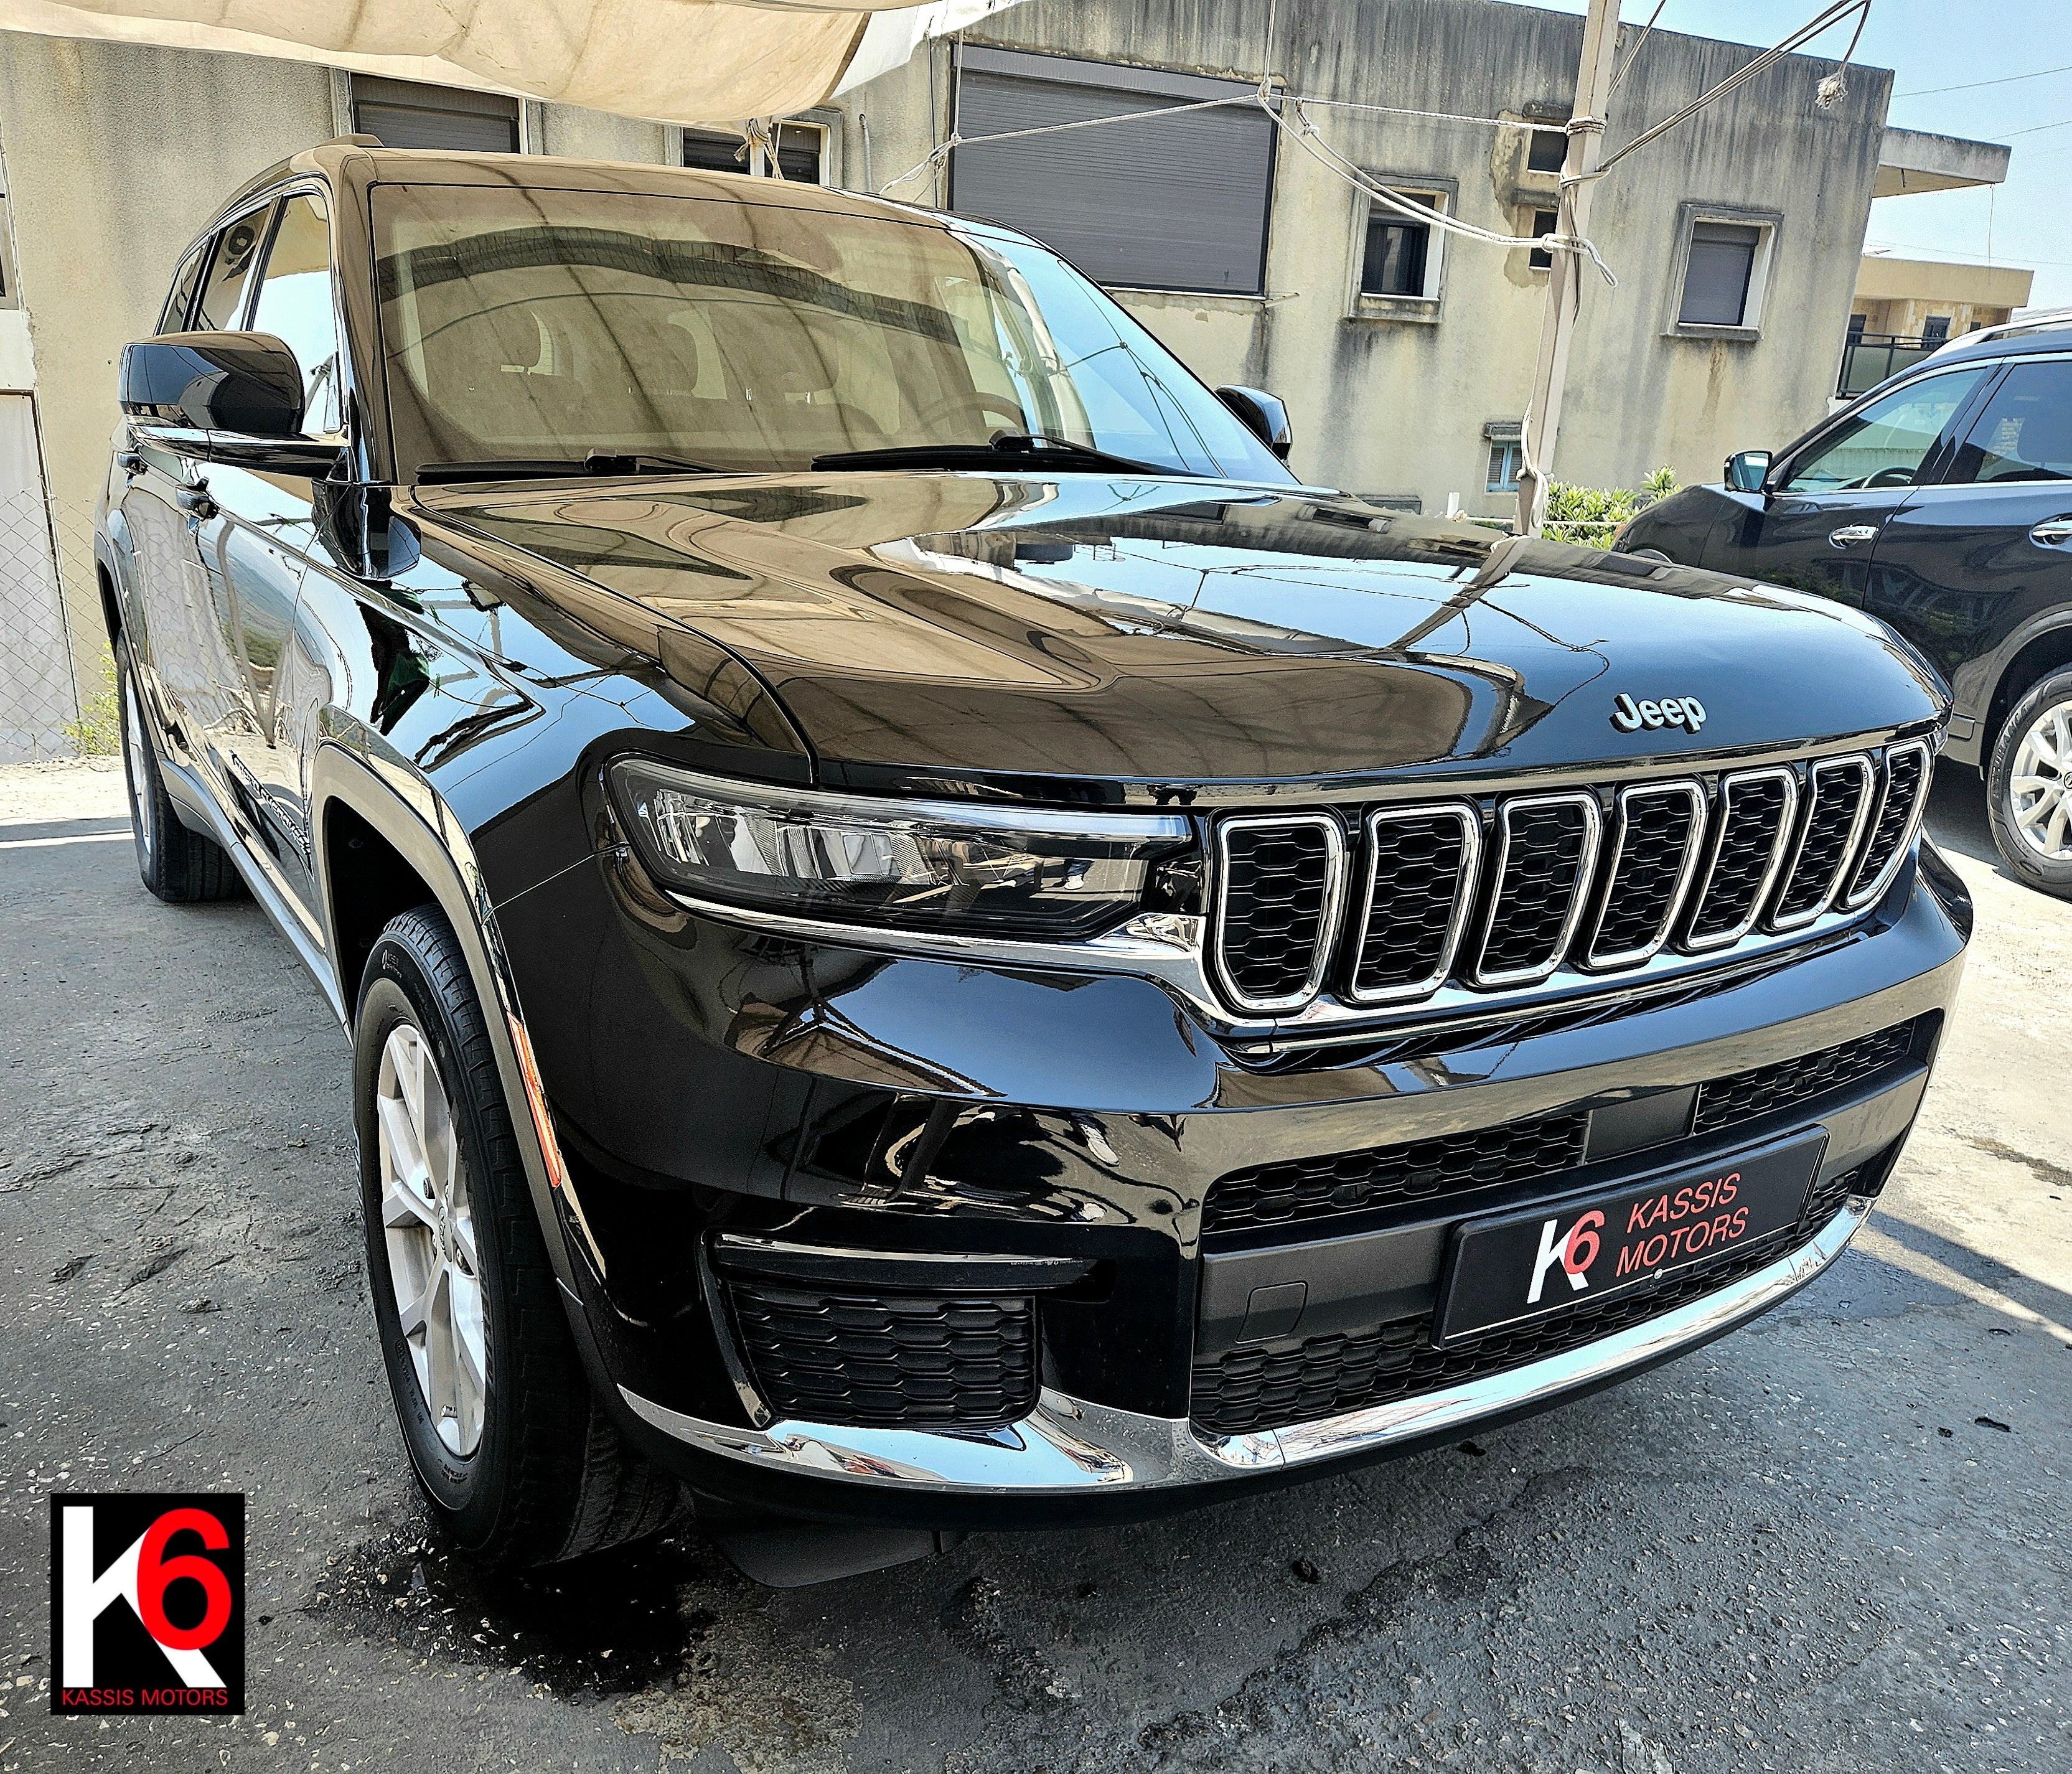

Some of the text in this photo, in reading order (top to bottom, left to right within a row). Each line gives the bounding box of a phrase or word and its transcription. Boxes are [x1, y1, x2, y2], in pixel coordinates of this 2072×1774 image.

[1610, 692, 1707, 734] Jeep
[1626, 1172, 1741, 1234] KASSIS
[1527, 1210, 1605, 1304] K6
[1615, 1206, 1750, 1277] MOTORS
